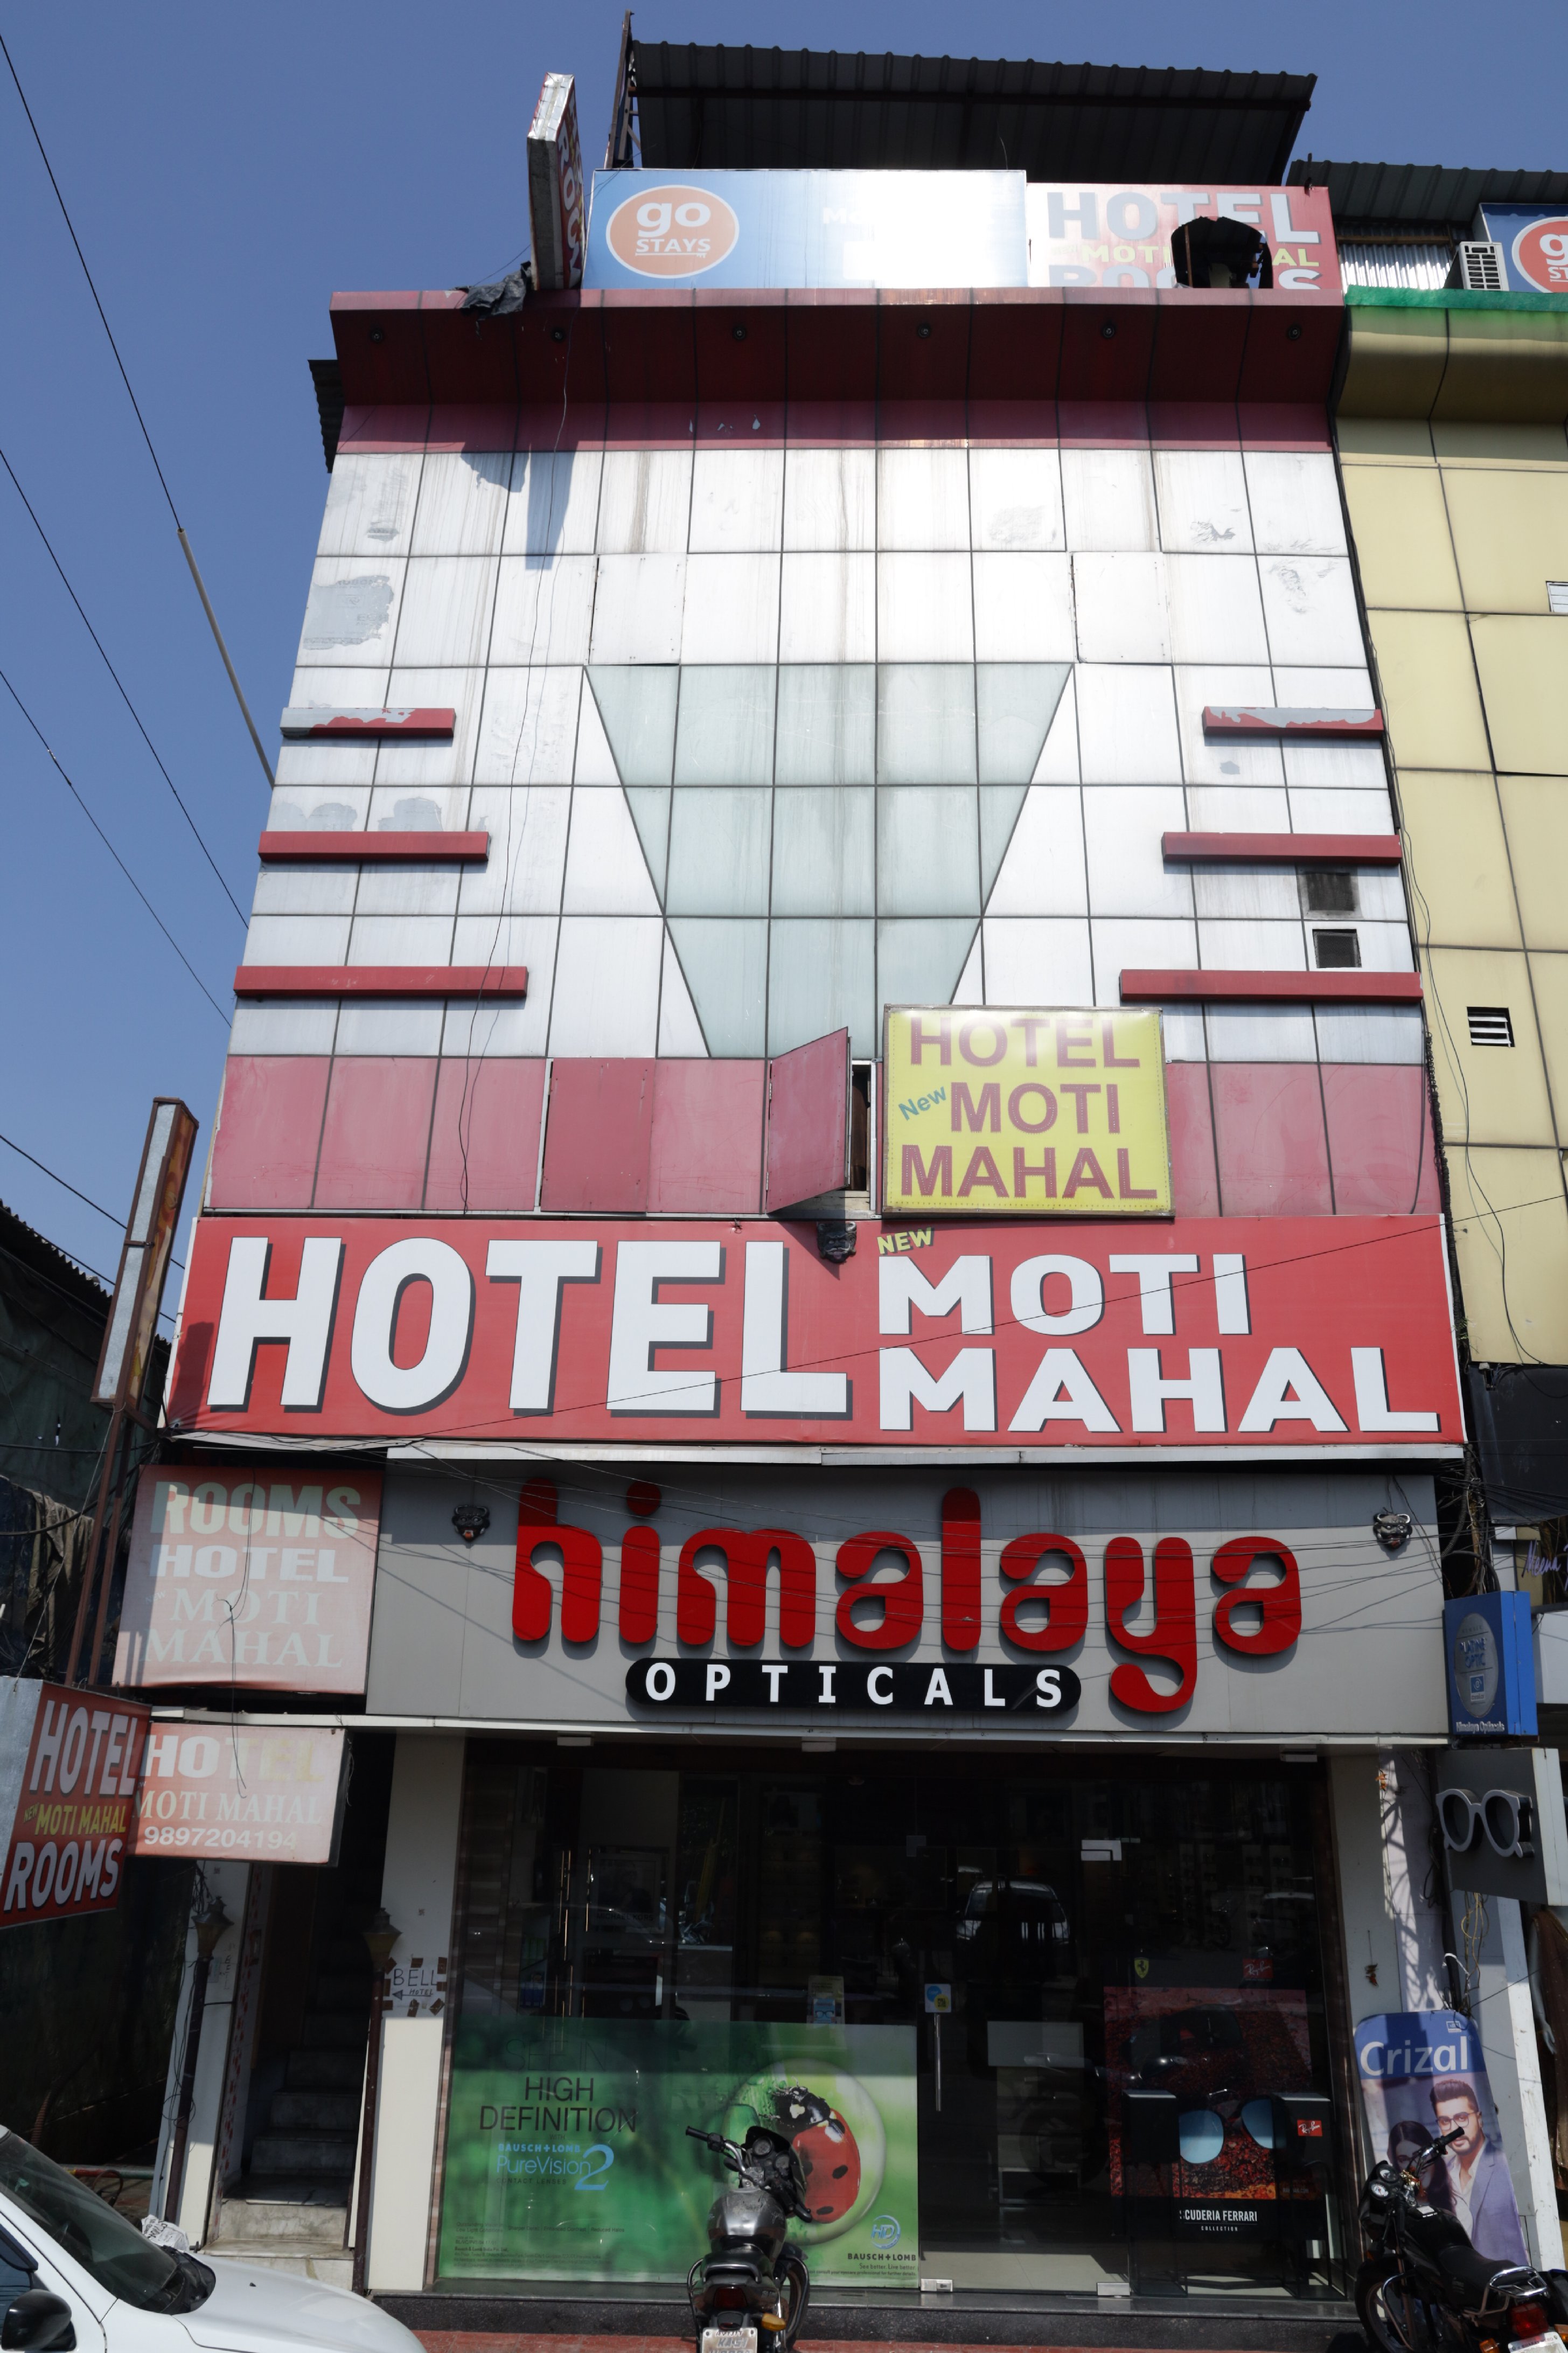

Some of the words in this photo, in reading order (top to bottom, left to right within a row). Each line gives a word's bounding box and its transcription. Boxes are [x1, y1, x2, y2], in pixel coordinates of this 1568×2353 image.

[636, 202, 711, 238] go
[1047, 191, 1320, 245] HOTEL
[636, 238, 711, 253] STAYS
[910, 1016, 1141, 1068] HOTEL
[898, 1086, 947, 1121] New
[950, 1082, 1121, 1134] MOTI
[901, 1144, 1158, 1200] MAHAL
[876, 1226, 935, 1255] NEW
[879, 1253, 1252, 1336] MOTI
[206, 1236, 850, 1417] HOTEL
[879, 1347, 1440, 1433] MAHAL
[150, 1481, 361, 1540] ROOMS
[149, 1544, 350, 1583] HOTEL
[169, 1587, 323, 1626] MOTI
[511, 1475, 1303, 1714] himalaya
[141, 1627, 345, 1668] MAHAL
[646, 1661, 1062, 1709] OPTICALS
[29, 1700, 138, 1797] HOTEL
[139, 1734, 325, 1783] HOTEL
[24, 1802, 38, 1824] NEW
[35, 1804, 78, 1835] MOTI
[78, 1806, 127, 1835] MAHAL
[133, 1790, 209, 1820] MOTI
[216, 1793, 322, 1825] MAHAL
[144, 1826, 296, 1850] 9897204194
[3, 1838, 124, 1913] ROOMS
[632, 1913, 654, 1922] KORS
[393, 1968, 437, 1987] BELL
[505, 2038, 568, 2071] SEE
[579, 2041, 607, 2072] IN
[1360, 2036, 1468, 2076] Crizal
[524, 2076, 594, 2102] HIGH
[479, 2105, 637, 2133] DEFINITION
[496, 2155, 591, 2175] PureVision
[574, 2143, 615, 2191] 2
[870, 2224, 895, 2240] HD
[1223, 2210, 1258, 2222] FERRARI
[847, 2252, 916, 2261] BAUSCH+LOMB
